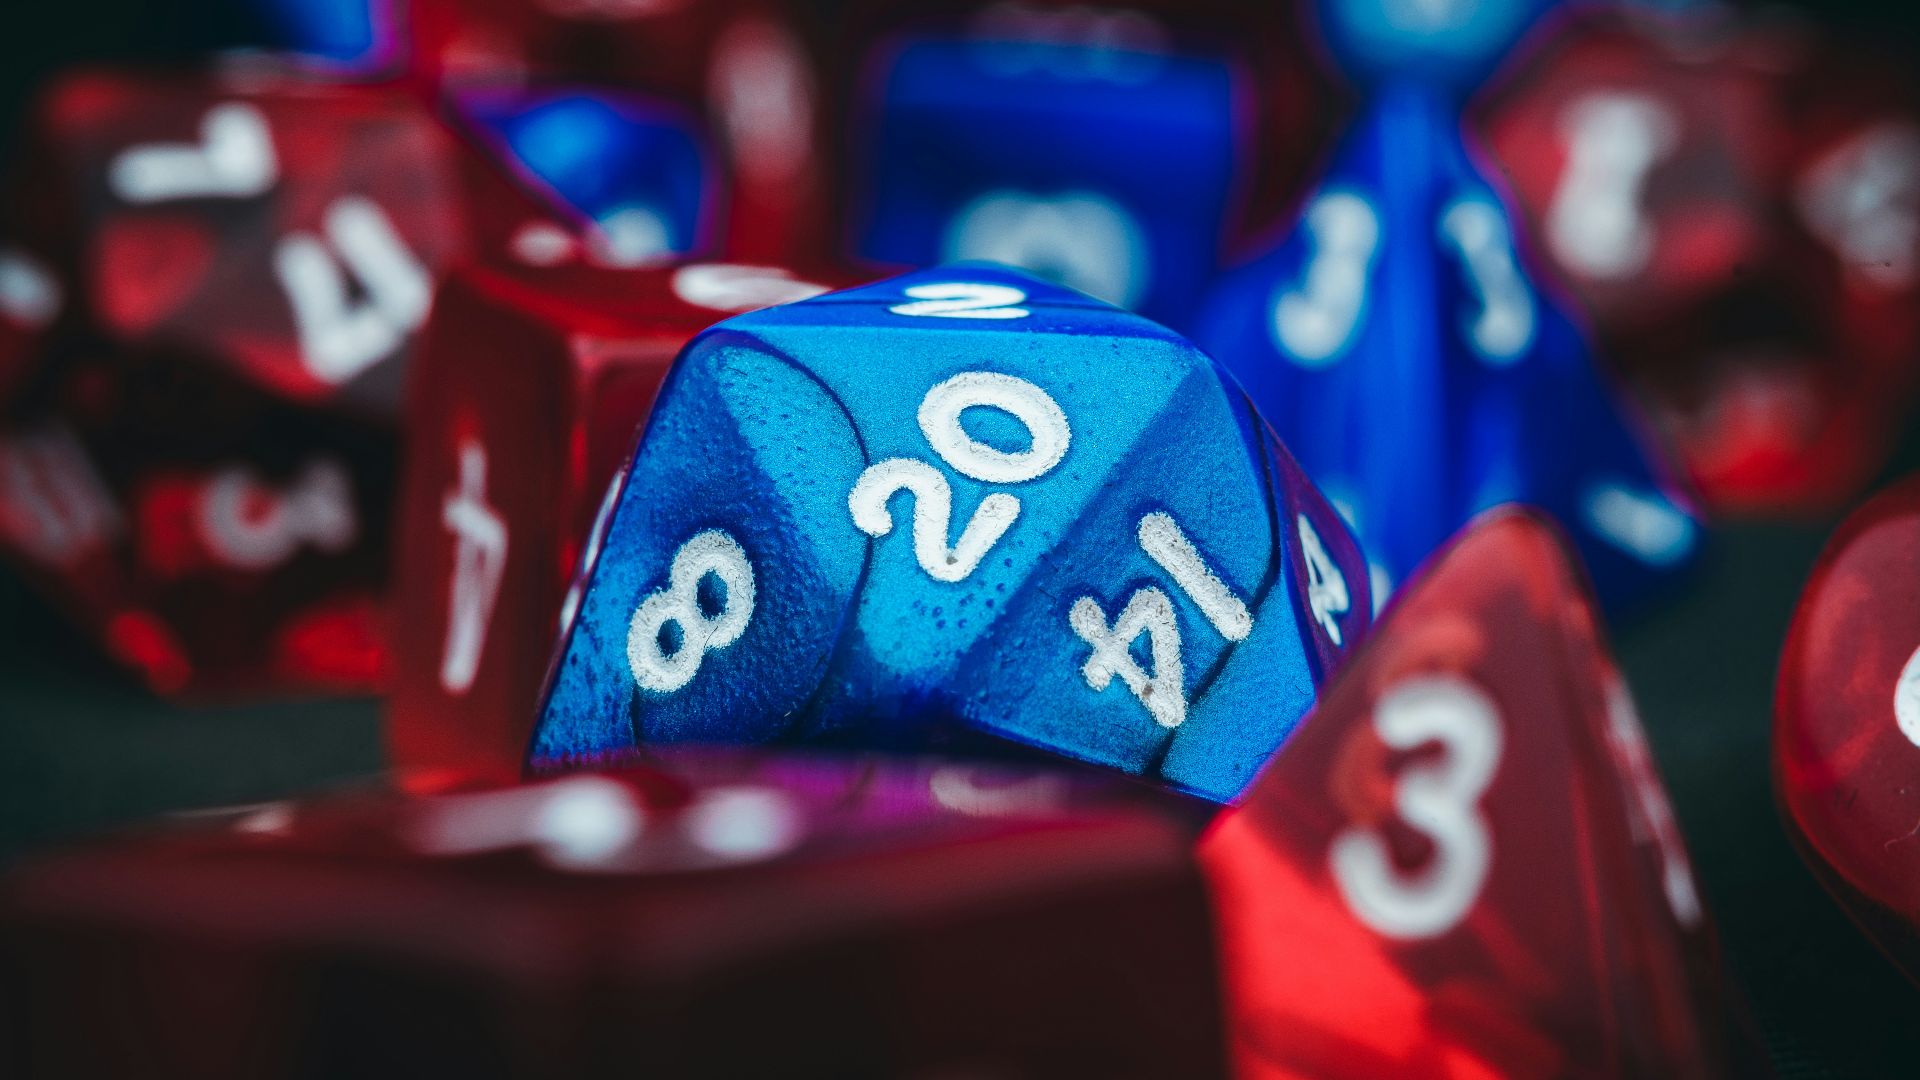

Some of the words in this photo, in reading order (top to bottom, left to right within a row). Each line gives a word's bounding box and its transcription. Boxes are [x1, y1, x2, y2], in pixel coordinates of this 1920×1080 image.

[889, 282, 1031, 319] 2
[848, 371, 1071, 582] 20
[627, 528, 758, 693] 8
[1068, 511, 1255, 729] 14
[1297, 513, 1350, 646] 4
[1331, 675, 1502, 940] 3
